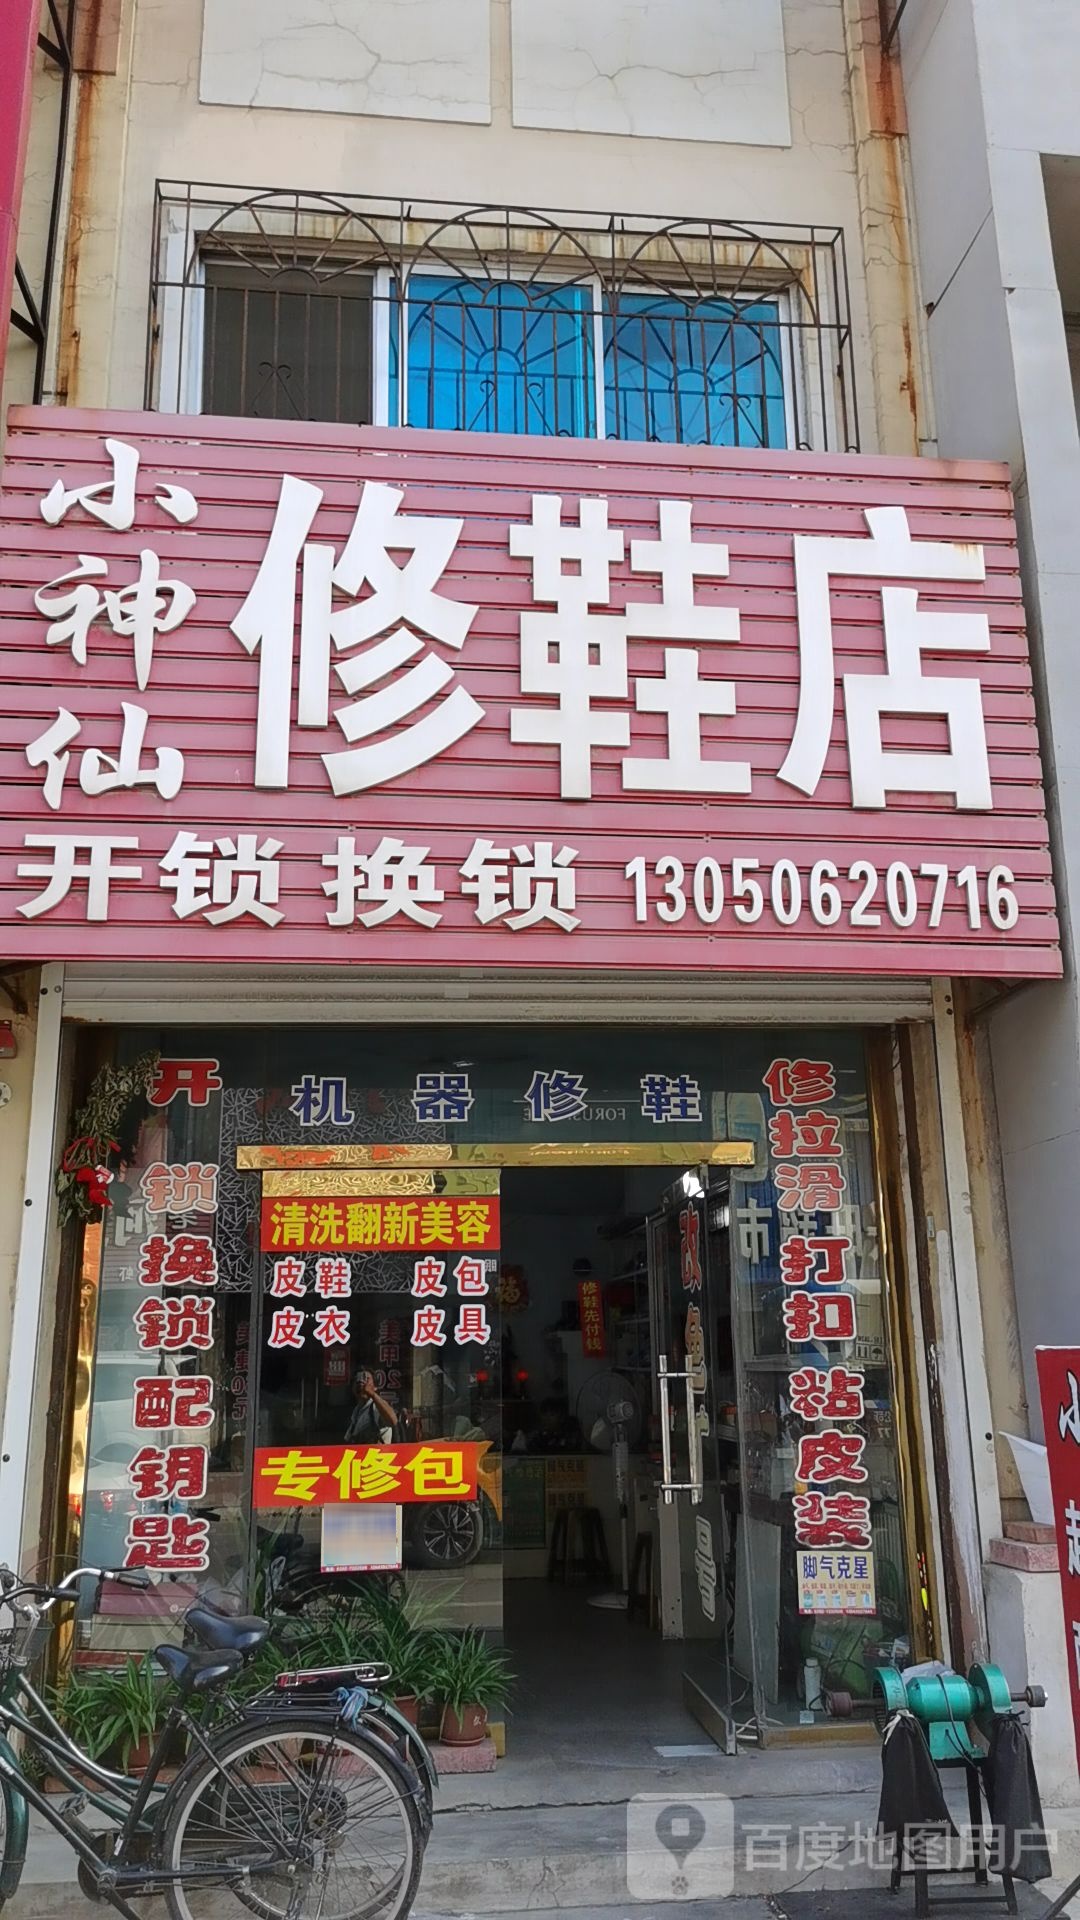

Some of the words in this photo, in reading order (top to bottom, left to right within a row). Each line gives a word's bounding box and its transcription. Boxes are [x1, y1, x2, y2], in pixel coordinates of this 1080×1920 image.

[26, 438, 199, 811] 小神仙
[229, 473, 994, 813] 修鞋店
[16, 830, 580, 932] 开锁换锁
[624, 855, 1019, 932] 13050620716
[288, 1070, 702, 1126] 机器修鞋
[270, 1201, 492, 1245] 清洗翻新美容
[272, 1256, 352, 1298] 皮鞋
[413, 1256, 490, 1297] 皮包
[268, 1306, 352, 1348] 皮衣
[410, 1304, 491, 1347] 皮具
[260, 1448, 472, 1502] 专修包
[802, 1555, 869, 1579] 脚气克星
